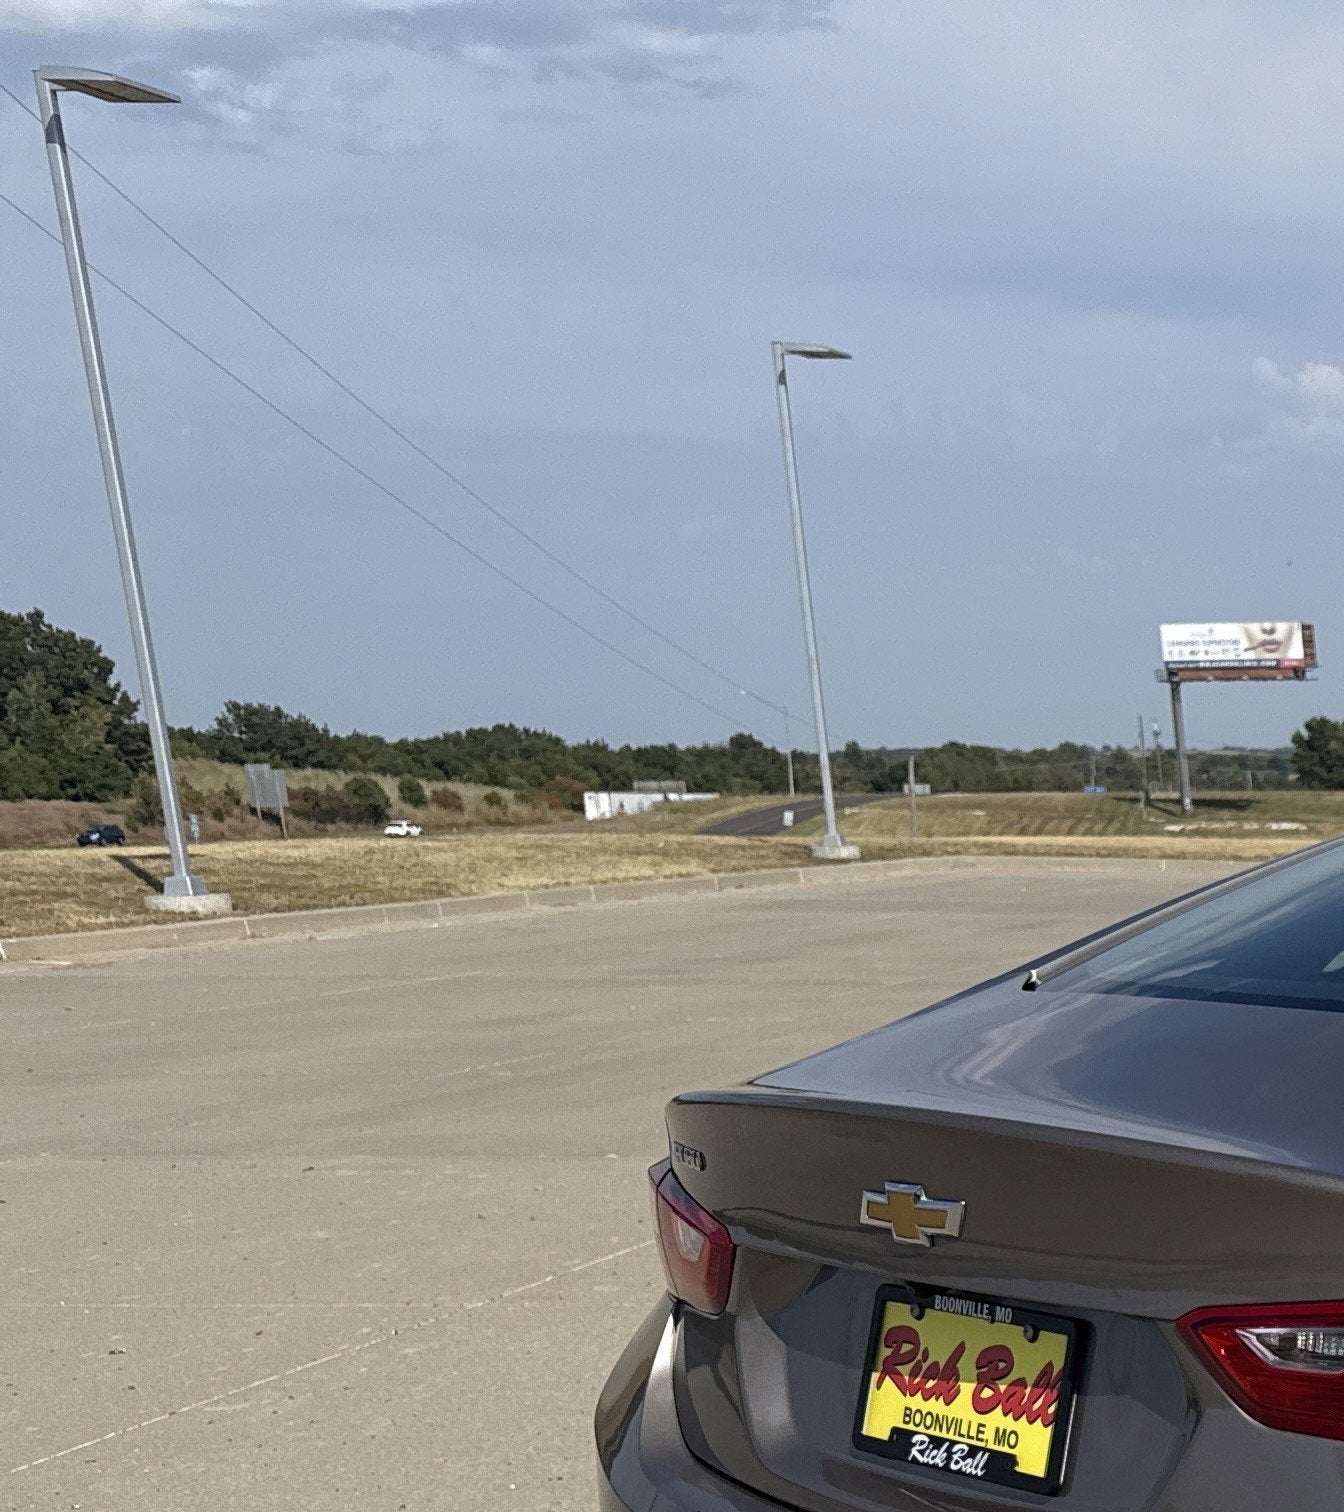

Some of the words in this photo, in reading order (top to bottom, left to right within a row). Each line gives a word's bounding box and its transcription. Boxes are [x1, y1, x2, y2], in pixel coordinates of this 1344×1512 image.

[934, 1295, 992, 1320] BOONVILLE,
[996, 1307, 1012, 1323] MO
[877, 1325, 966, 1405] Rick
[971, 1344, 1064, 1427] Ball
[903, 1407, 989, 1444] BOONVILLE,
[993, 1427, 1019, 1450] MO
[908, 1434, 947, 1468] Rick
[949, 1445, 990, 1477] Ball
